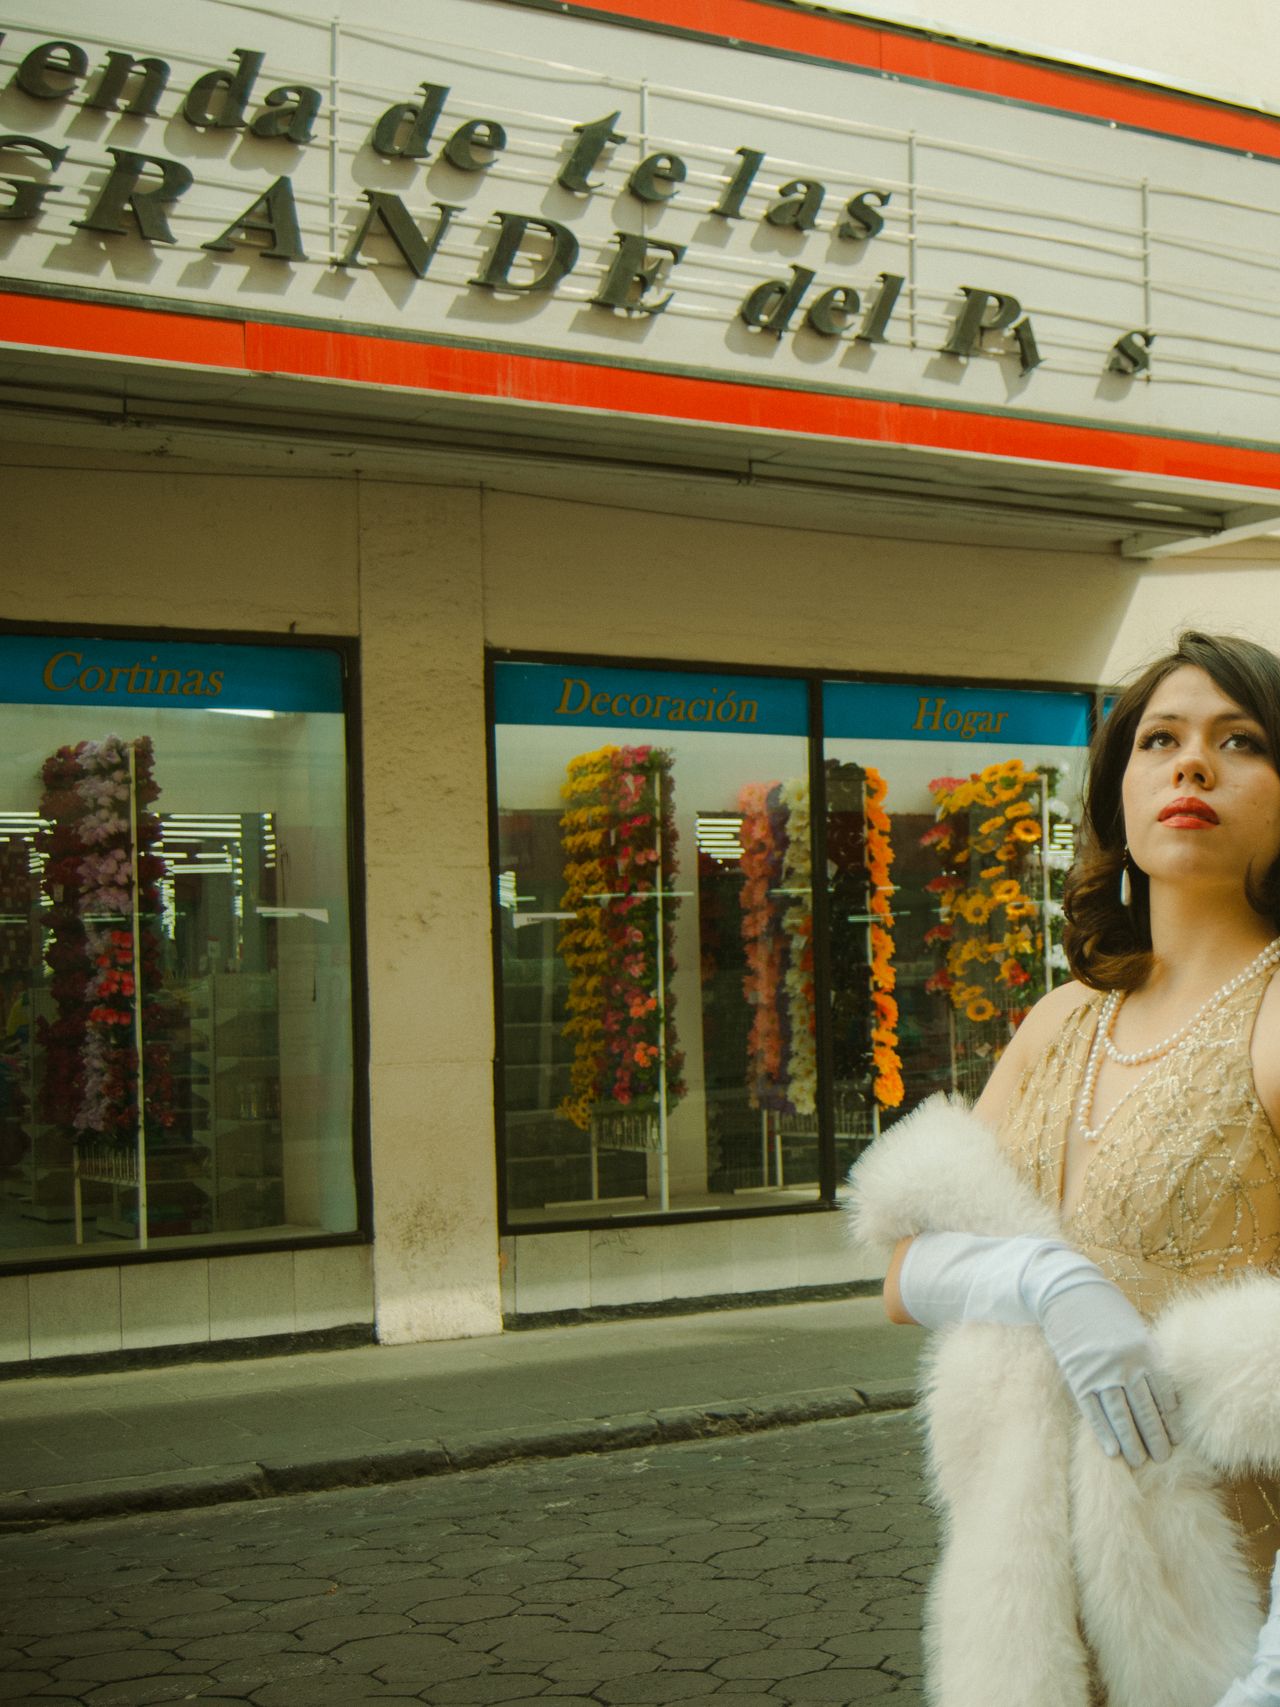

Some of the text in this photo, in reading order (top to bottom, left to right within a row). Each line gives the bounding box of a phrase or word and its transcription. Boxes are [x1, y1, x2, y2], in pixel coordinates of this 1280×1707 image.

[0, 33, 892, 242] enda de telas
[0, 133, 688, 318] GRANDE
[739, 263, 905, 345] del
[42, 650, 225, 698] Cortinas
[554, 677, 759, 723] Decoración
[911, 696, 1009, 740] Hogar
